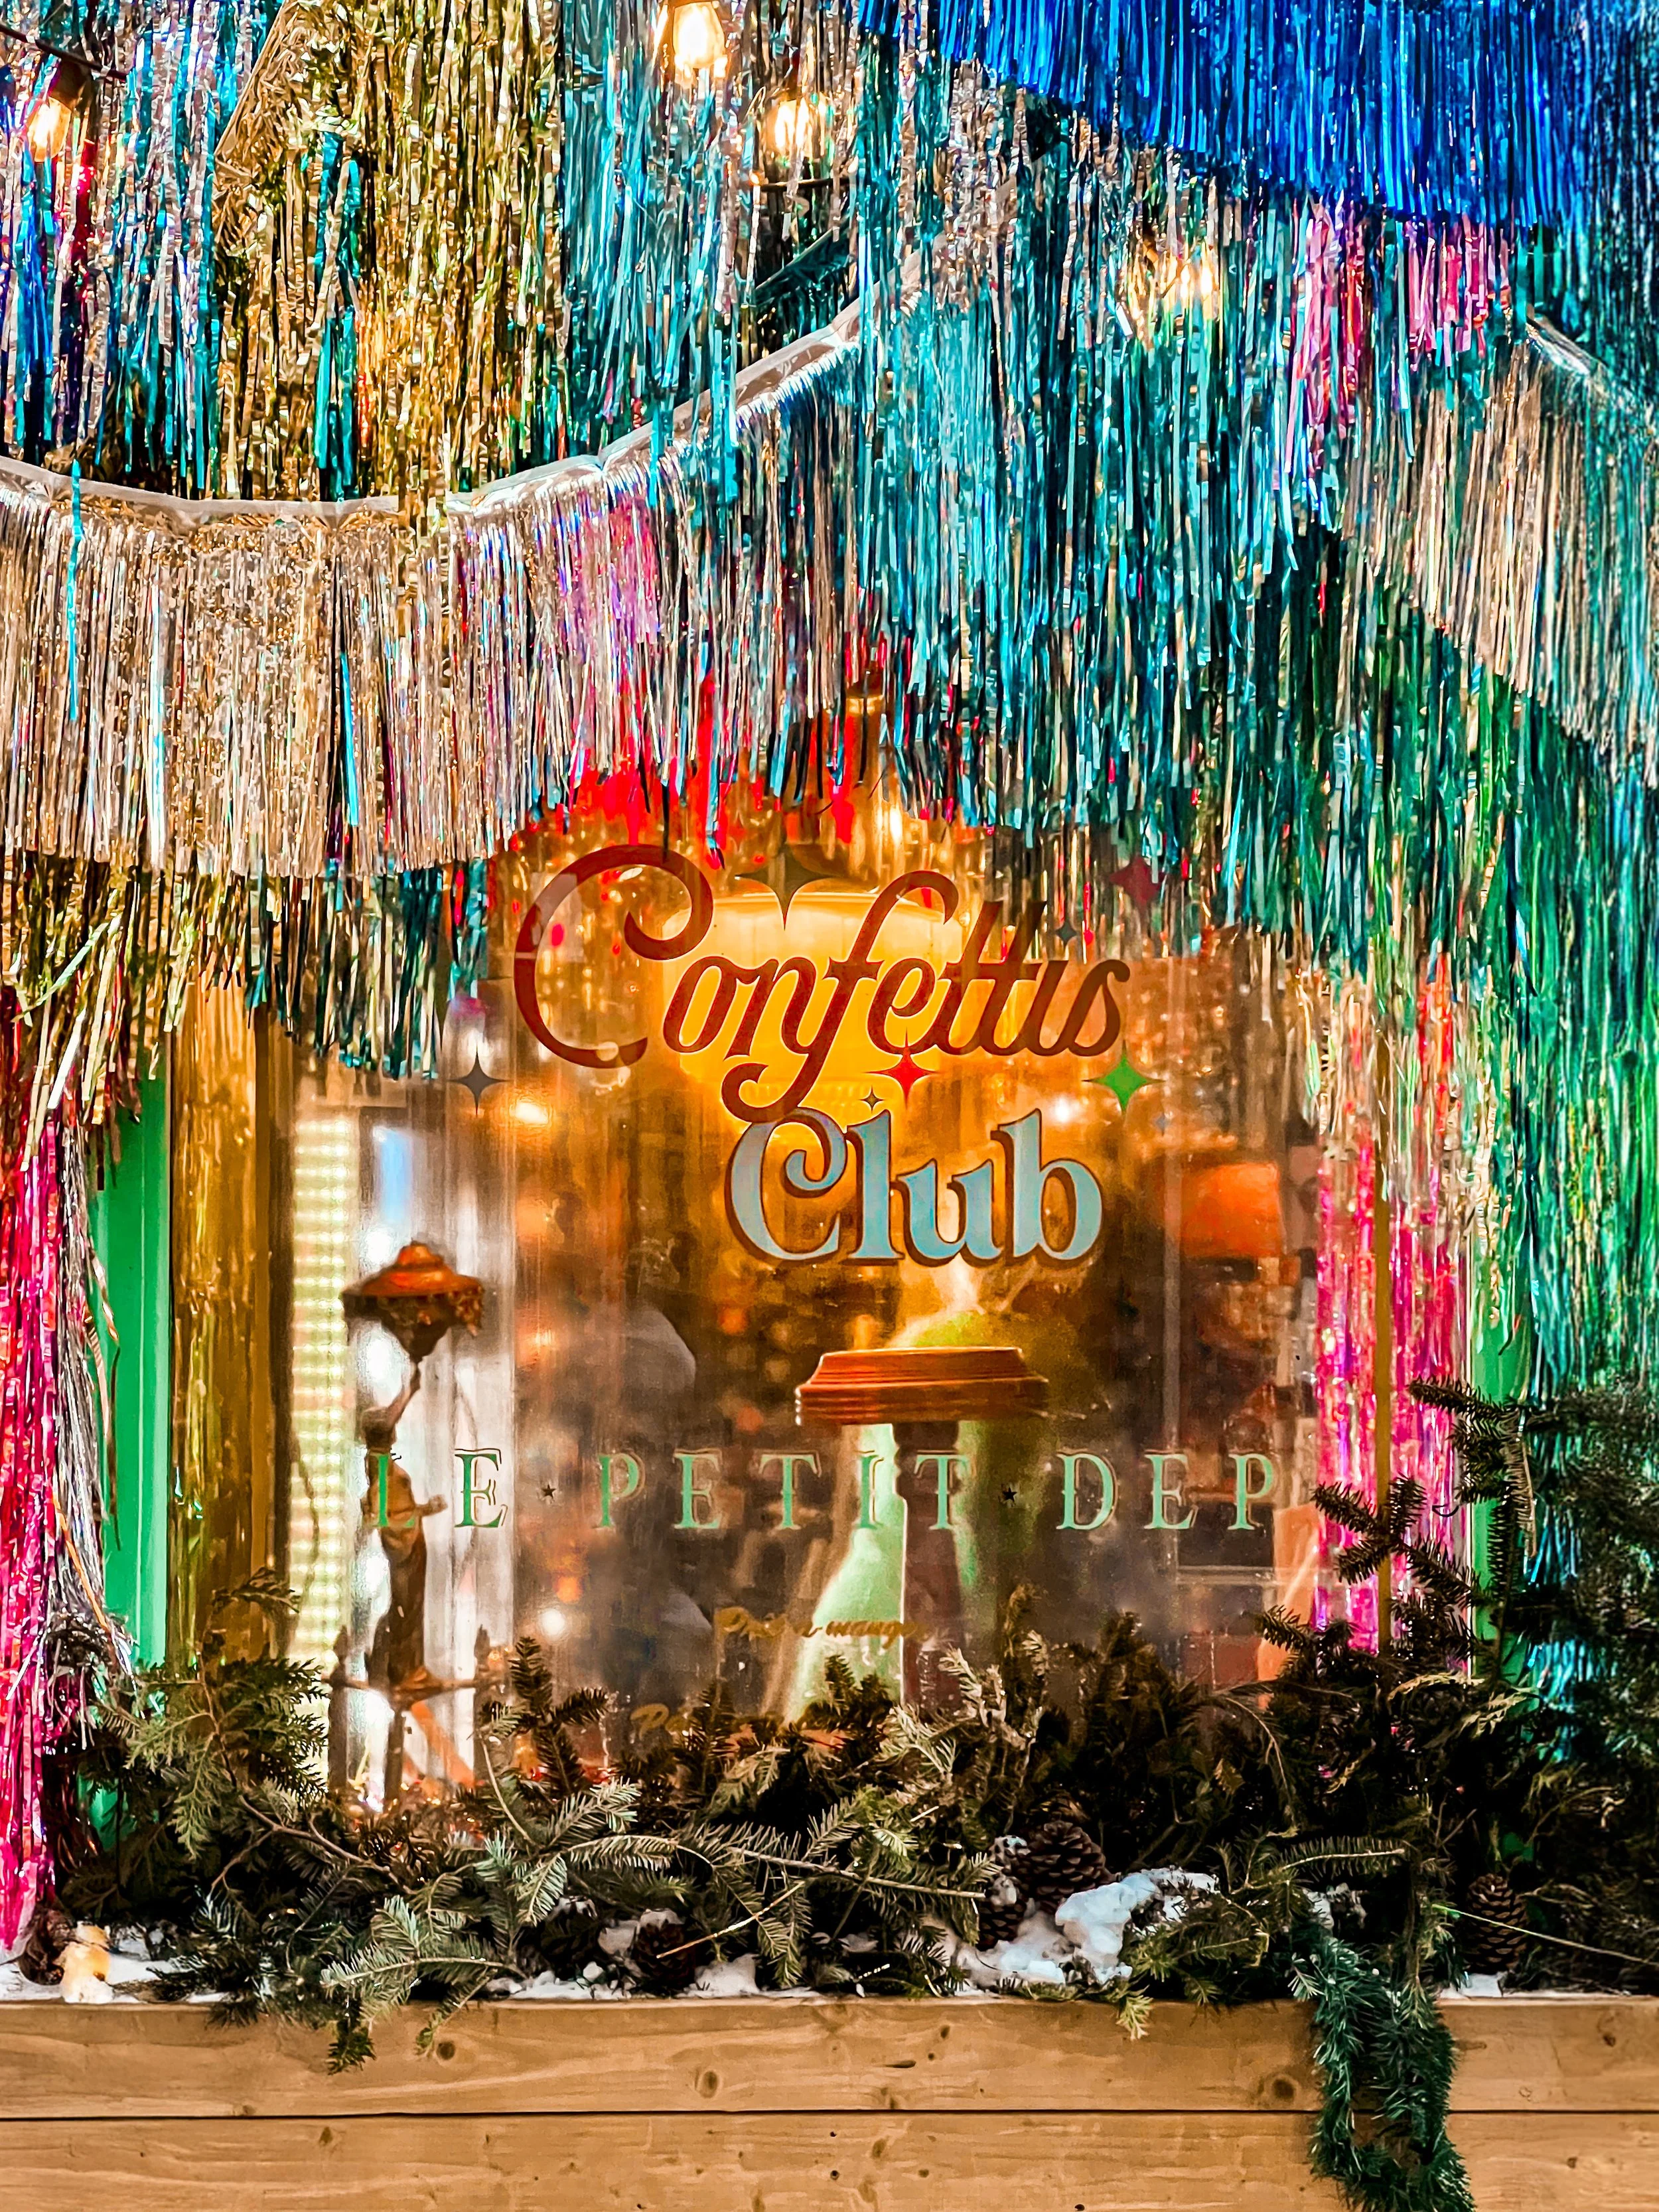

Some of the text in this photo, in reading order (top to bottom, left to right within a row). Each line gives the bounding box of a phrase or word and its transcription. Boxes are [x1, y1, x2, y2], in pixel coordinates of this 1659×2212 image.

[513, 844, 1131, 1123] Confettis
[724, 1106, 1103, 1268] Club
[362, 1448, 1278, 1530] LE PETIT DEP
